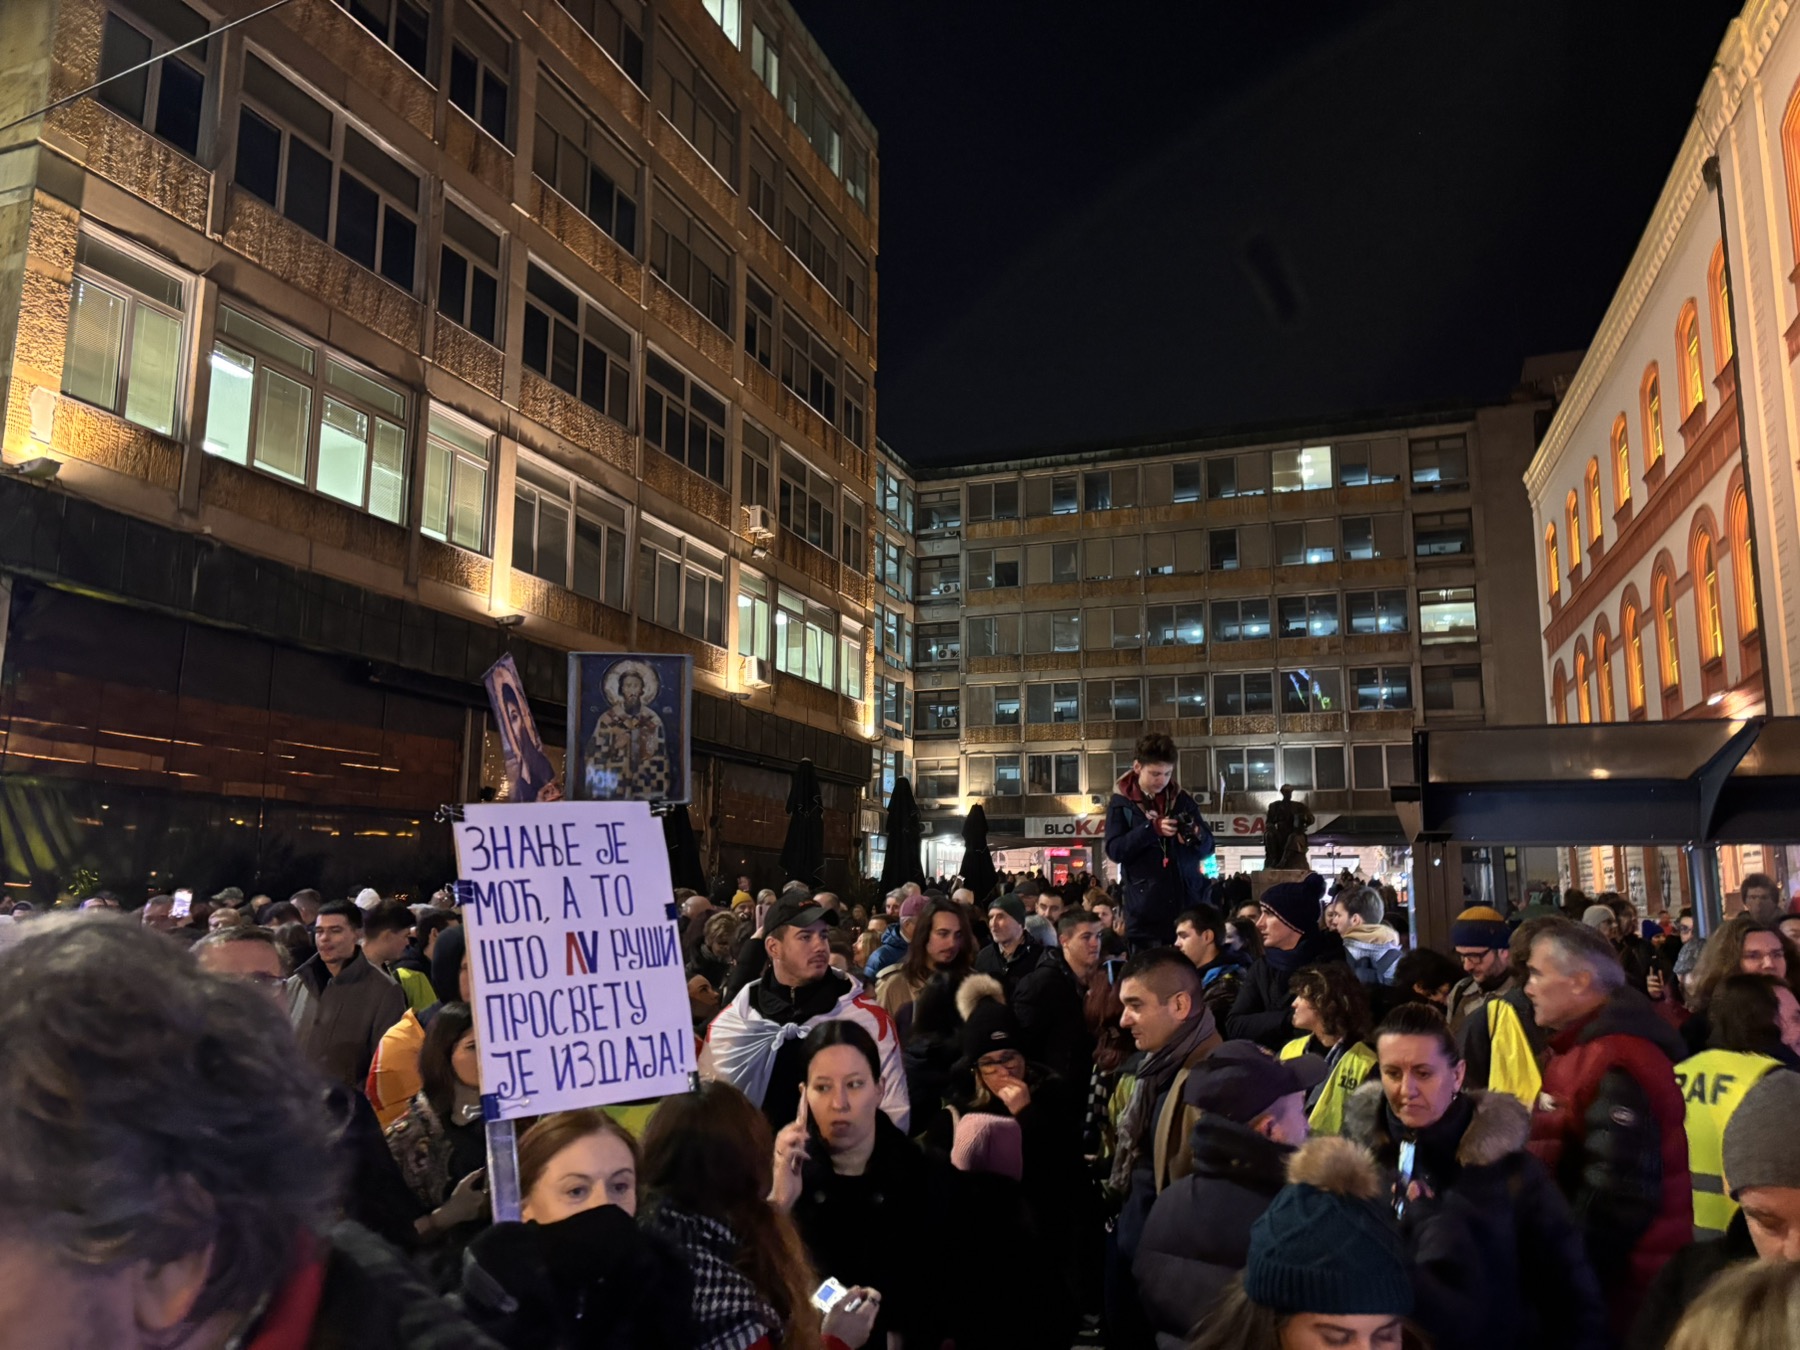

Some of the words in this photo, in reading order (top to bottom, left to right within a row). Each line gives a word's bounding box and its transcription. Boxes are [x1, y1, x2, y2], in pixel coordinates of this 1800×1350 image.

[465, 822, 582, 871] ЗНАЊЕ
[595, 822, 630, 865] ЈЕ
[473, 879, 550, 926] МОЋ,
[562, 876, 582, 919] А
[590, 874, 634, 918] ТО
[480, 935, 549, 984] ШТО
[610, 924, 679, 971] РУШИ
[485, 980, 648, 1043] ПРОСВЕТУ
[490, 1049, 540, 1099] ЈЕ
[550, 1028, 685, 1091] ИЗДАЈА!
